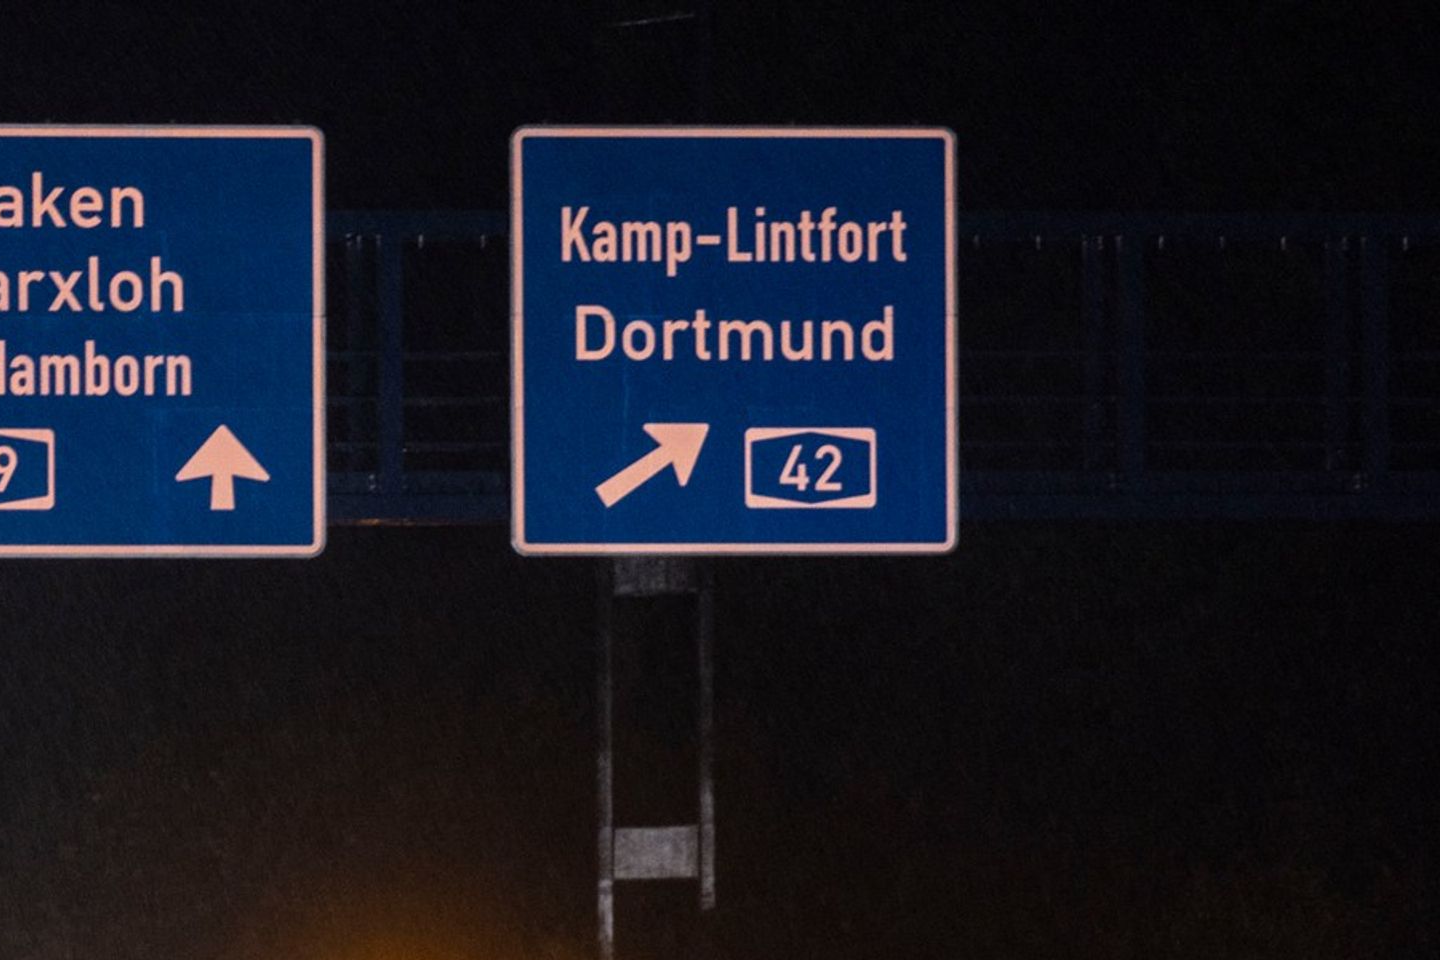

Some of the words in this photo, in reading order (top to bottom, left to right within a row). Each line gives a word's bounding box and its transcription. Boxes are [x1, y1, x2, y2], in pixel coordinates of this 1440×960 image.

[561, 206, 907, 277] Kamp-Lintfort
[575, 304, 894, 361] Dortmund
[778, 444, 842, 492] 42
